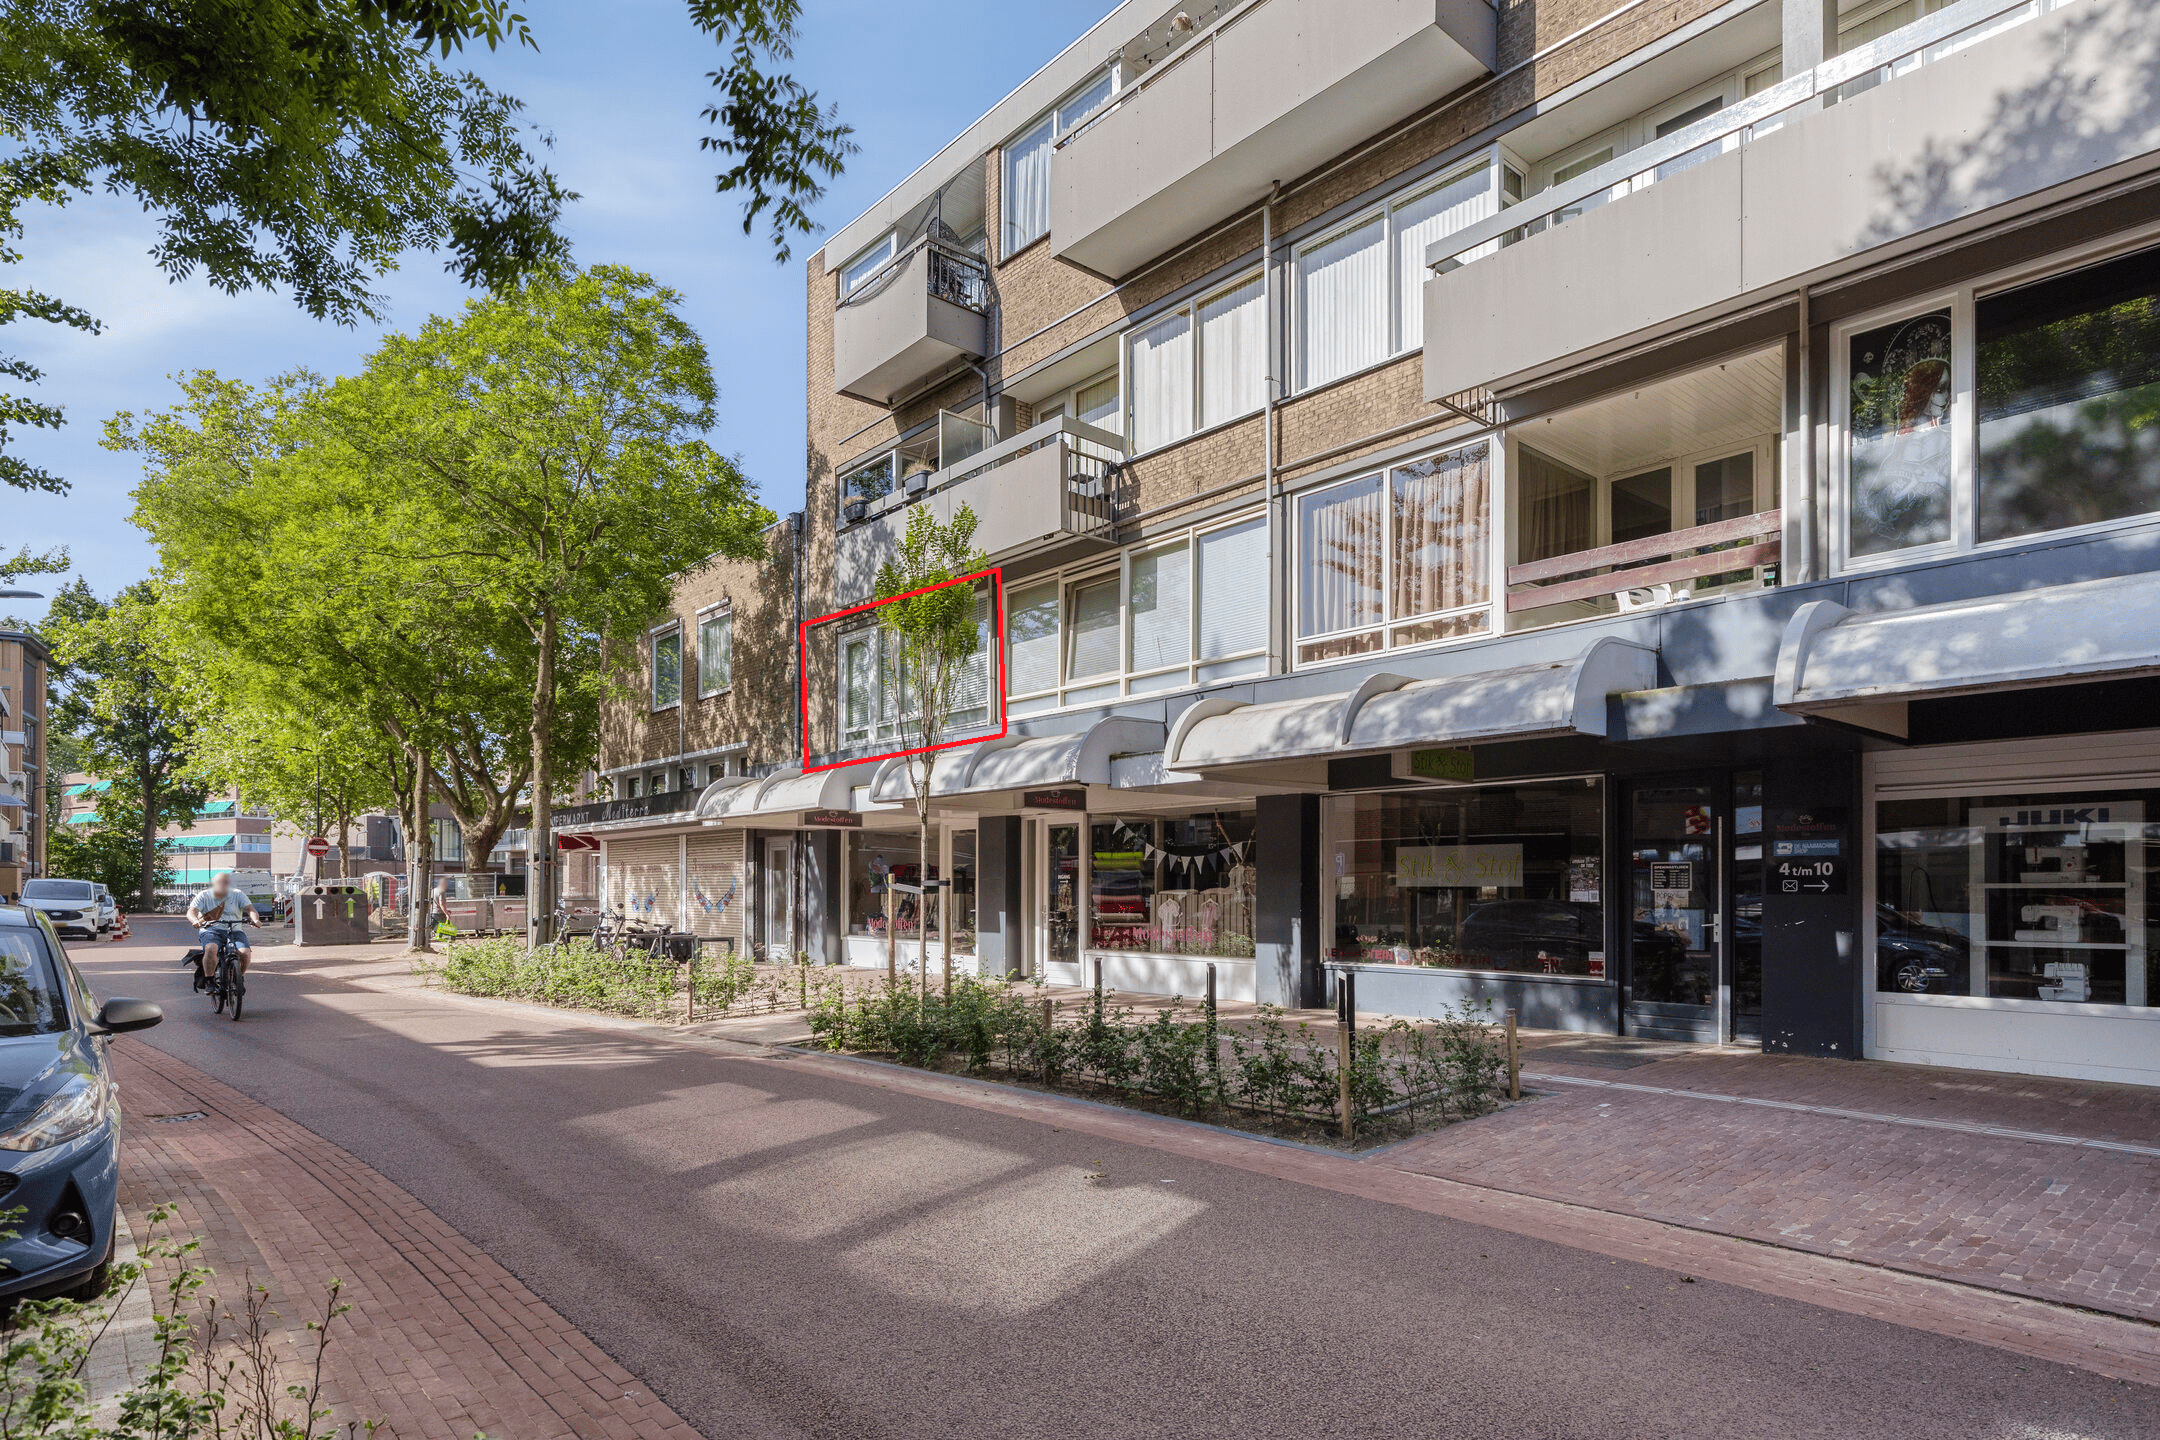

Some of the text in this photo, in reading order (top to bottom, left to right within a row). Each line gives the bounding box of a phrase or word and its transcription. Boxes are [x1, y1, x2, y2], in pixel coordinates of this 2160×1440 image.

[1414, 752, 1434, 770] Stik
[1033, 795, 1078, 806] Modestoffen
[550, 803, 650, 827] UPERMARKT Mediterra
[814, 815, 853, 823] Modestoffen
[1999, 807, 2110, 827] JUKI
[1399, 855, 1435, 878] Stik
[1473, 852, 1521, 881] Stof
[1779, 862, 1834, 876] 4 t/m 10
[867, 918, 914, 930] Modeoffen
[1132, 926, 1213, 942] Modestoffen
